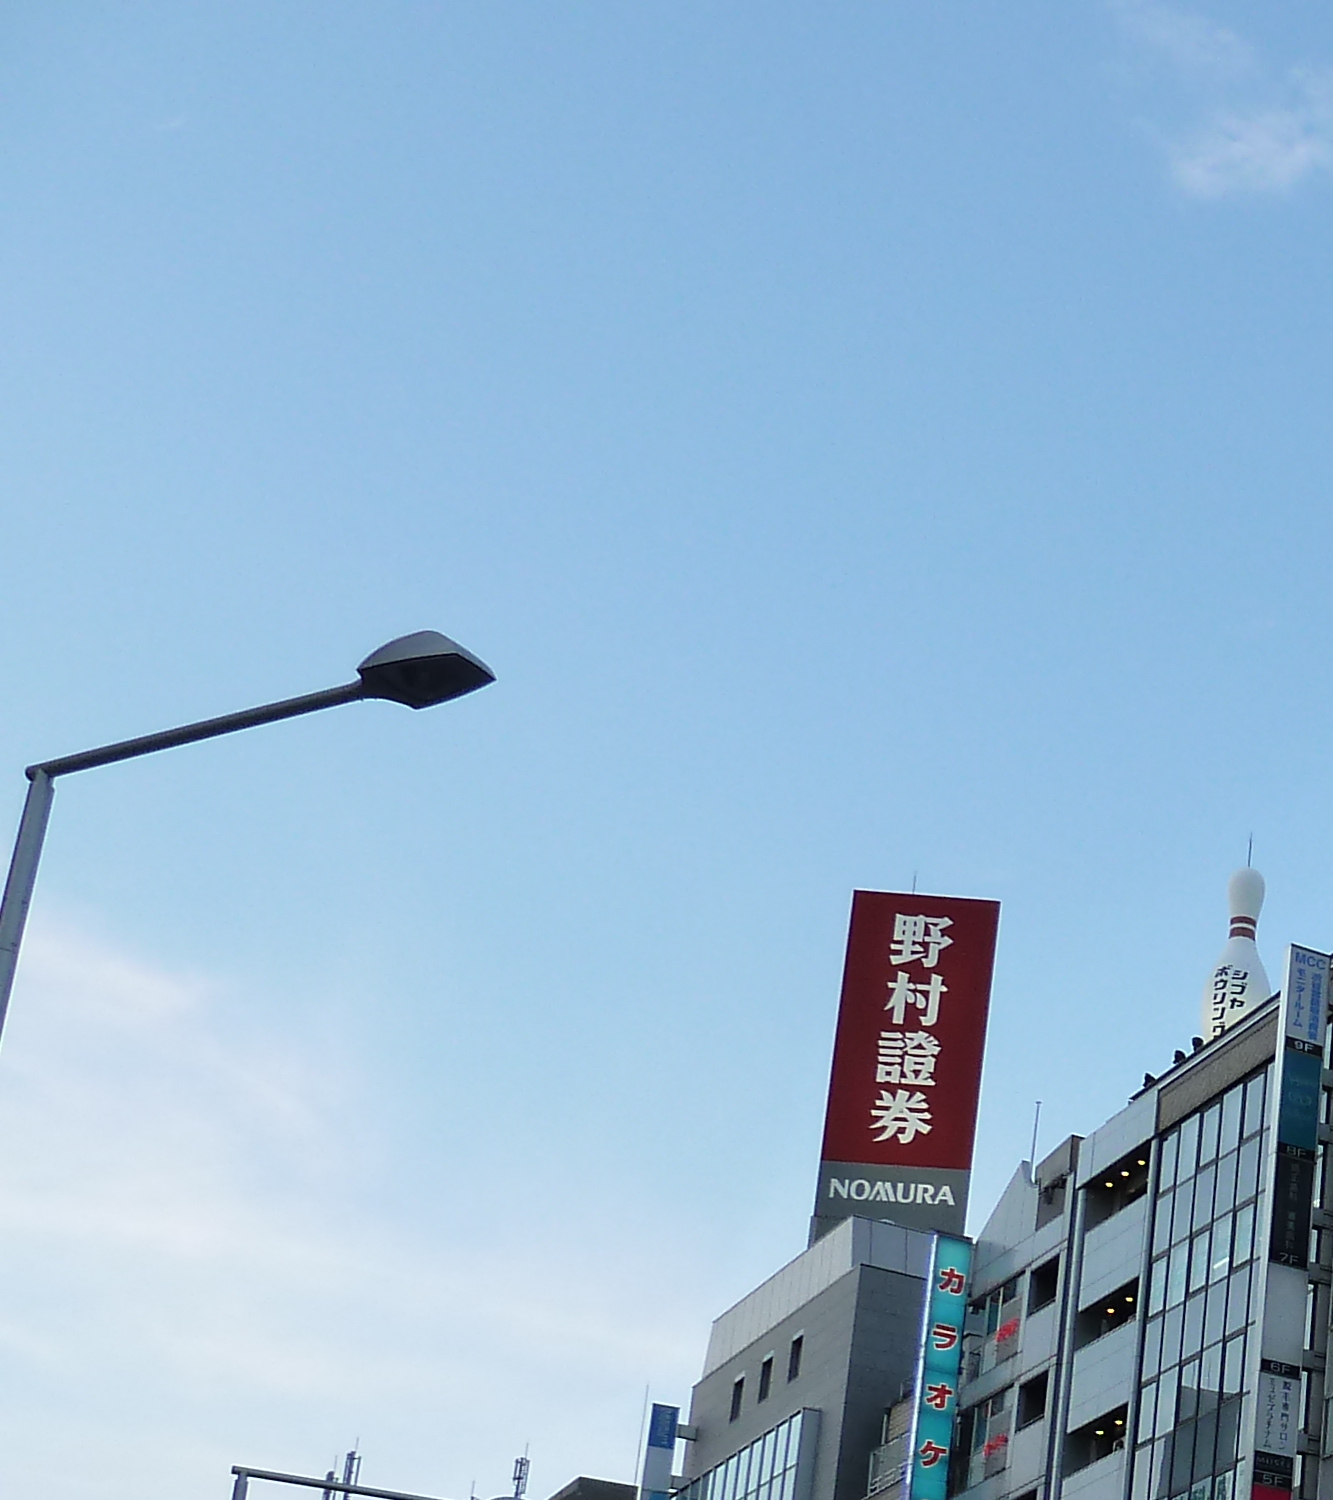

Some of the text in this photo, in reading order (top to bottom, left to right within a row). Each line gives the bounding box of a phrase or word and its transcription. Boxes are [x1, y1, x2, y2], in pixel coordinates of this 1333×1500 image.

[1295, 952, 1326, 970] MCC
[869, 913, 954, 1144] 野村證券
[1294, 1041, 1315, 1053] 9F
[829, 1177, 956, 1206] NOMURA
[1279, 1251, 1299, 1264] 7F
[1270, 1362, 1291, 1373] 6F
